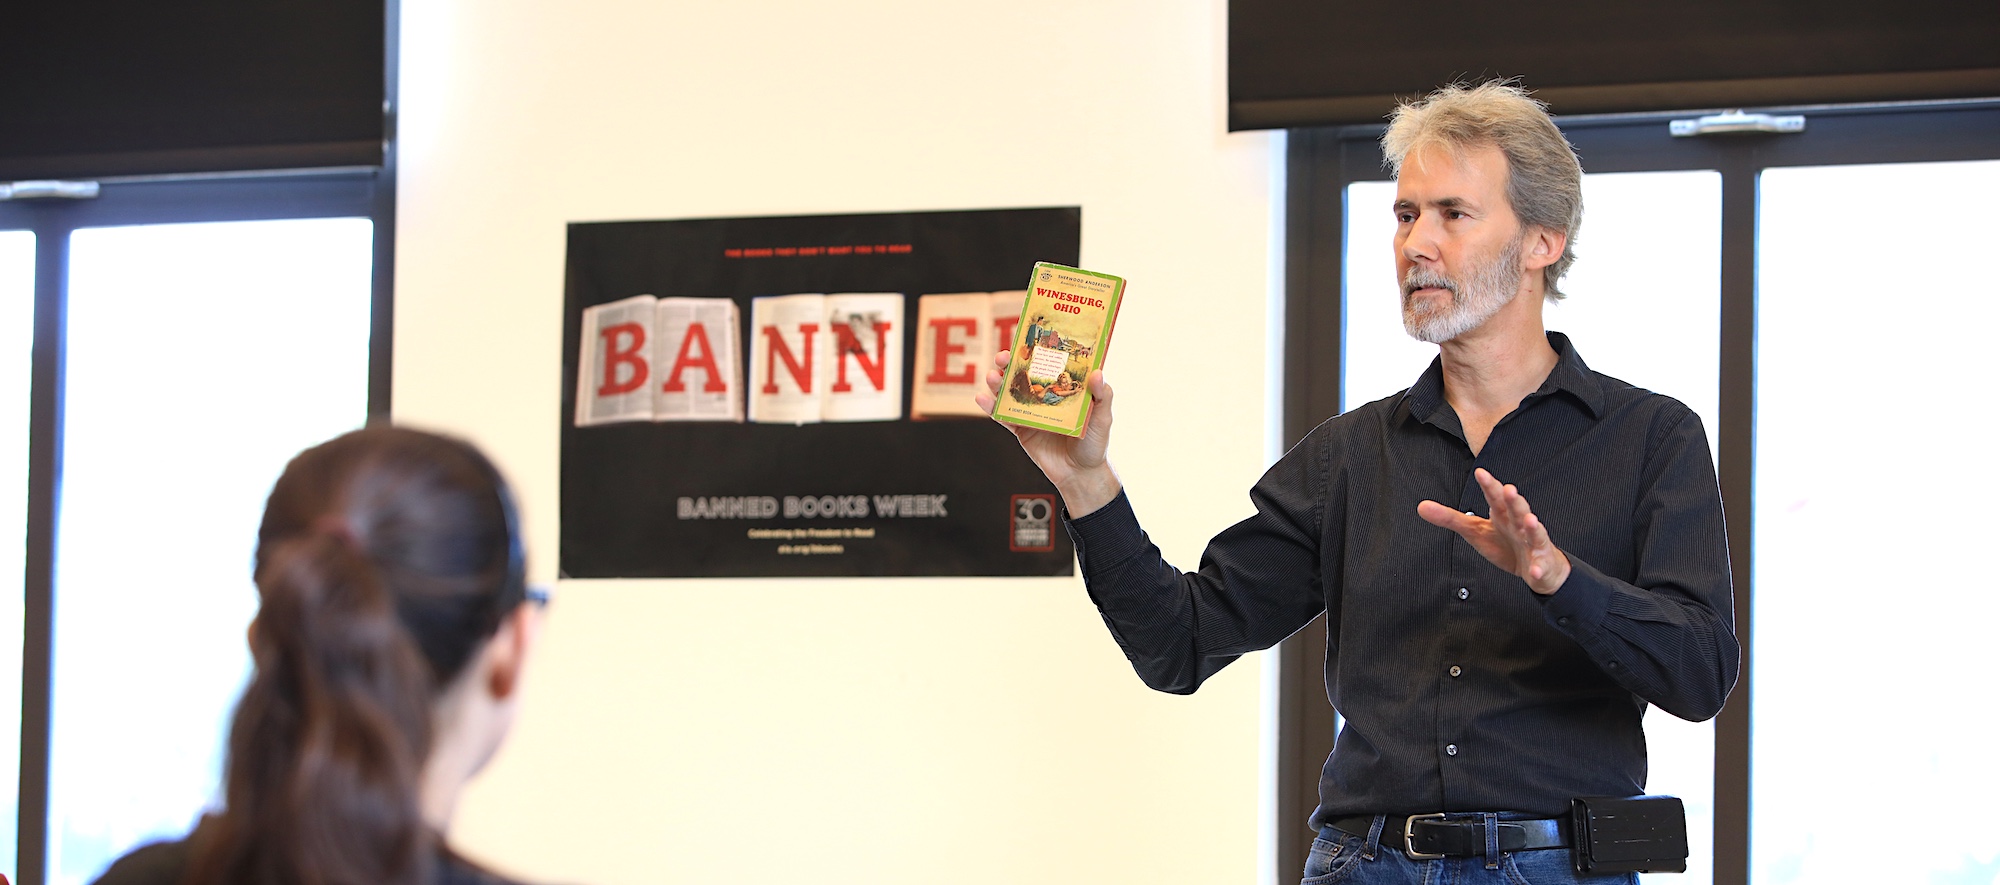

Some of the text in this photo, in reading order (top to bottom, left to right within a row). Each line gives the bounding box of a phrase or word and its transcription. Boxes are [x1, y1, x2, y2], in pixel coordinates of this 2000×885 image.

[1058, 274, 1084, 284] SHERWOOD
[1085, 279, 1111, 289] ANDERSON
[1036, 287, 1105, 310] WINESBURG,
[1053, 302, 1081, 314] OHIO
[677, 494, 948, 519] BANNED BOOKS WEEK
[1014, 498, 1052, 522] 30
